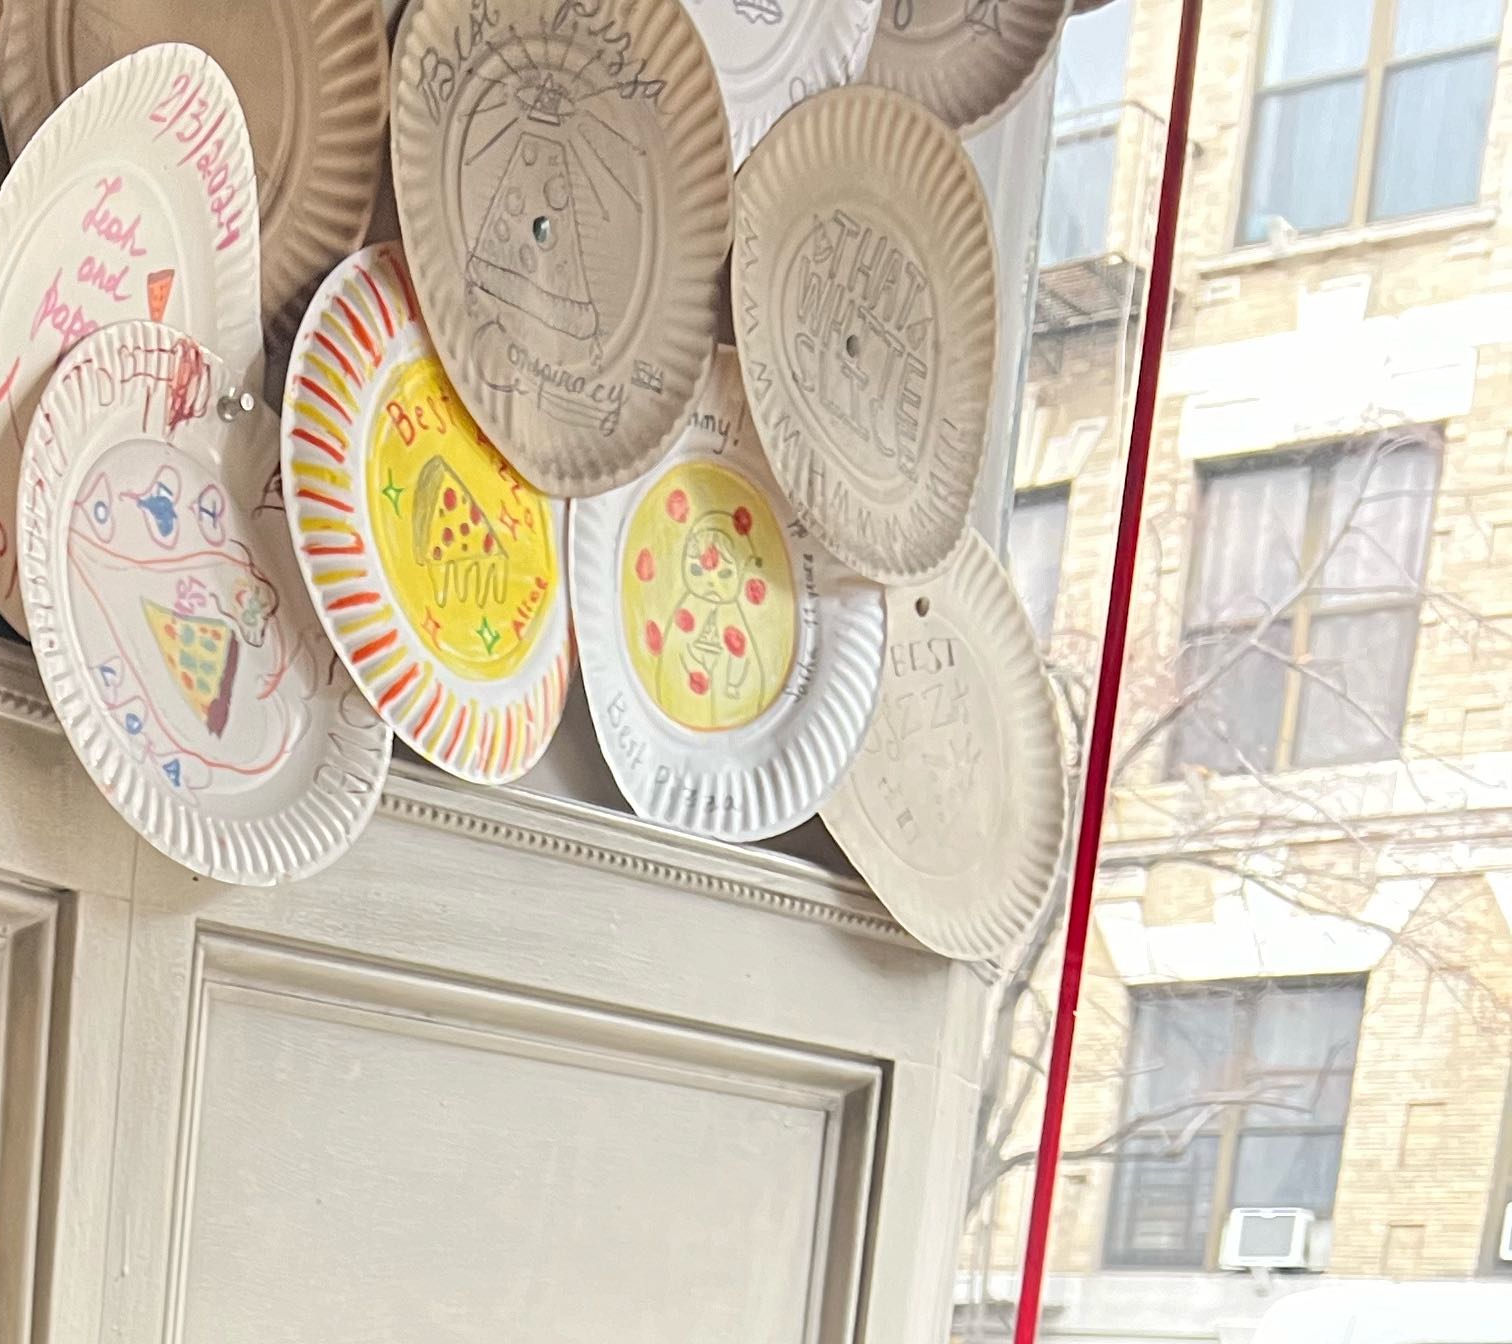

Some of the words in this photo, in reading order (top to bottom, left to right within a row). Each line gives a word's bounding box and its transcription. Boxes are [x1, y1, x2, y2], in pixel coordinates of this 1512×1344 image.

[148, 73, 241, 252] 2/3/2024
[471, 314, 629, 437] Conspiracy
[889, 637, 960, 678] BEST
